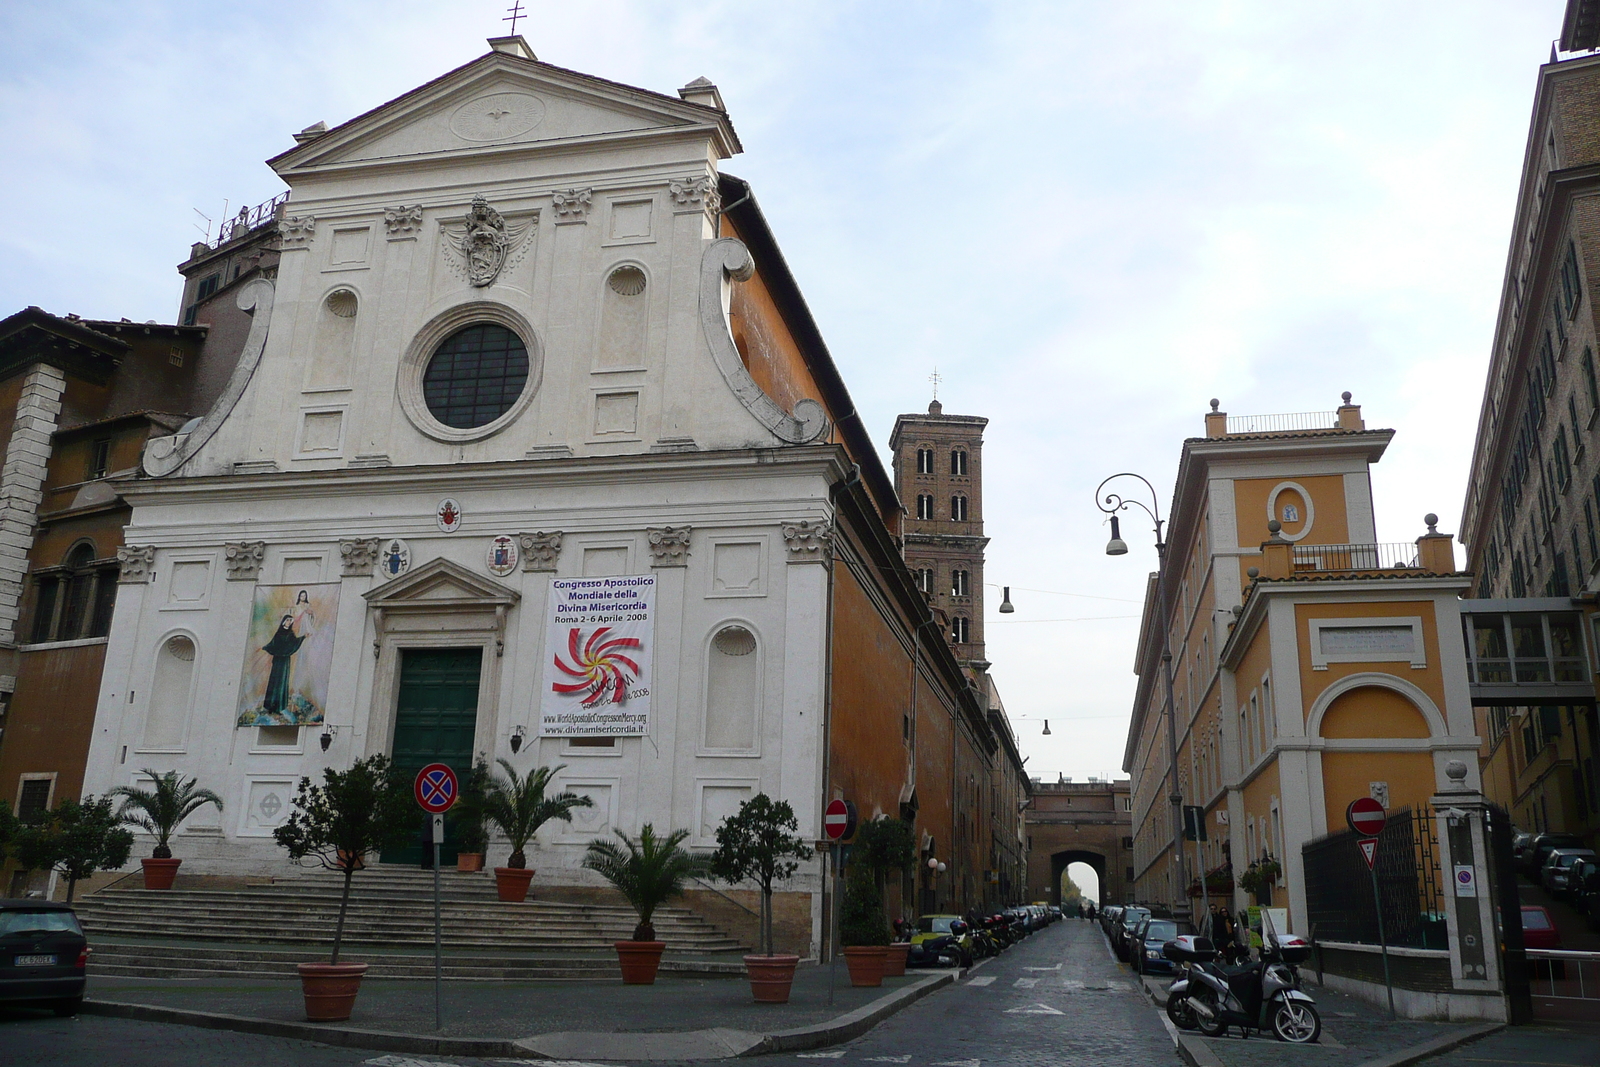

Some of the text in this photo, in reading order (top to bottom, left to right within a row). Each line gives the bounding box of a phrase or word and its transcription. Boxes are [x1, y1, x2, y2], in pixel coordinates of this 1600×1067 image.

[554, 578, 654, 590] Congresso Apostolico
[568, 590, 638, 600] Mondiale della
[557, 602, 647, 613] Divina Misericordia
[597, 614, 623, 624] Aprile
[626, 613, 648, 621] 2008
[632, 688, 650, 699] 2008
[545, 725, 644, 734] www.divinamisericordia.it
